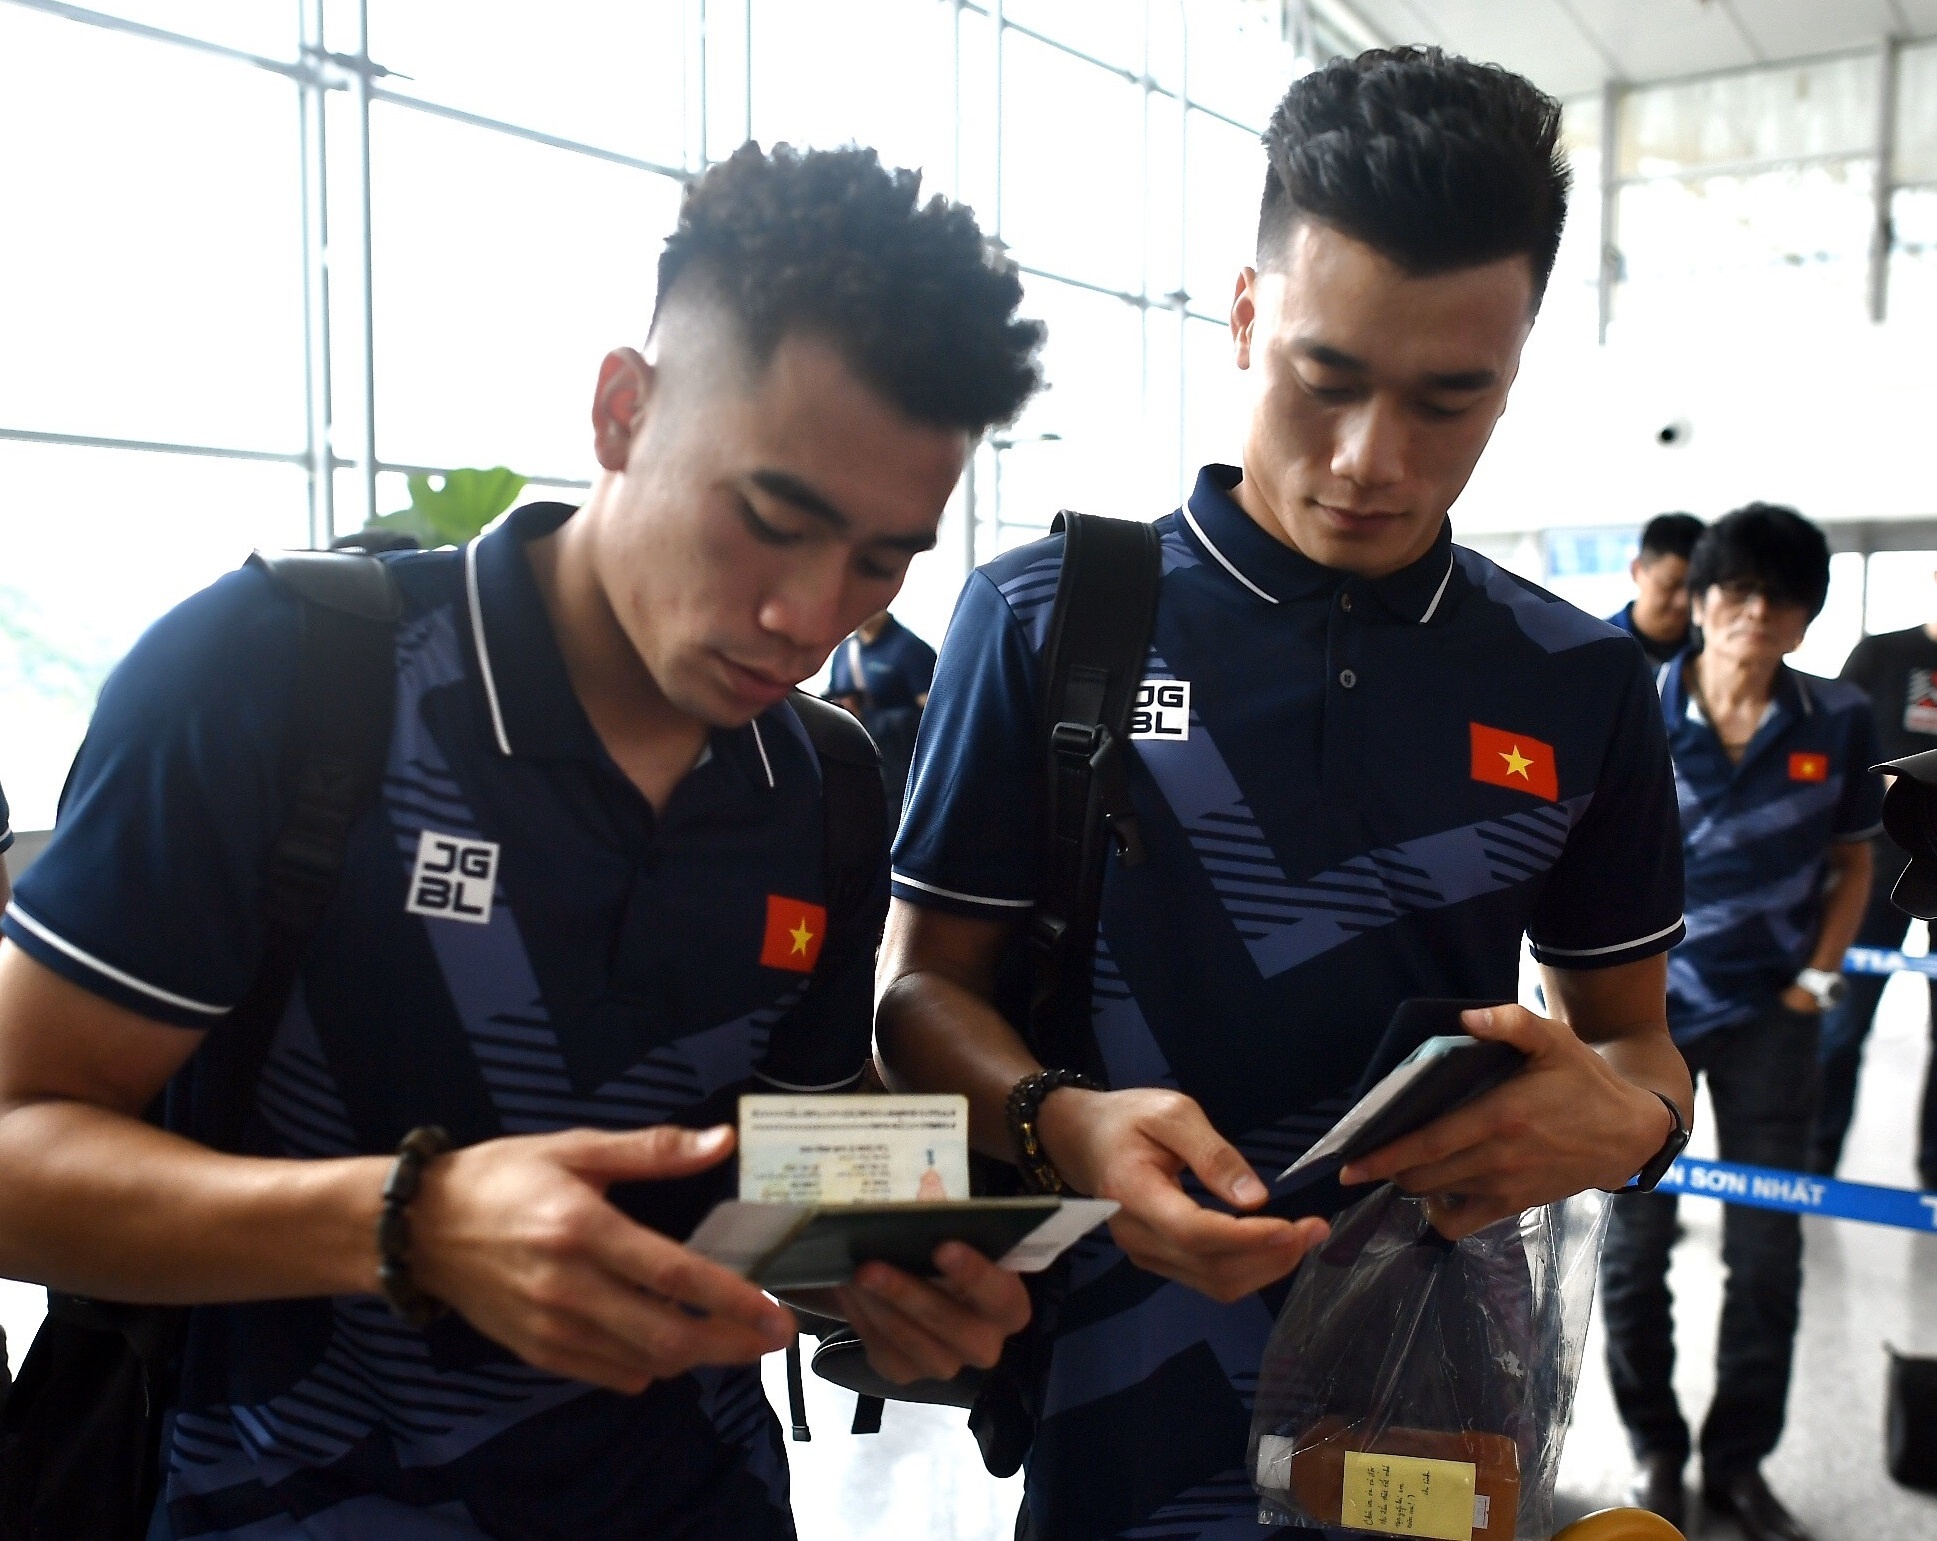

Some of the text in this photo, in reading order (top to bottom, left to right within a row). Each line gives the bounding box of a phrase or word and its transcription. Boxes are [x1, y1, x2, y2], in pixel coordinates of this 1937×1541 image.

[1129, 711, 1182, 734] BL
[423, 841, 491, 880] JG
[416, 875, 484, 915] BL
